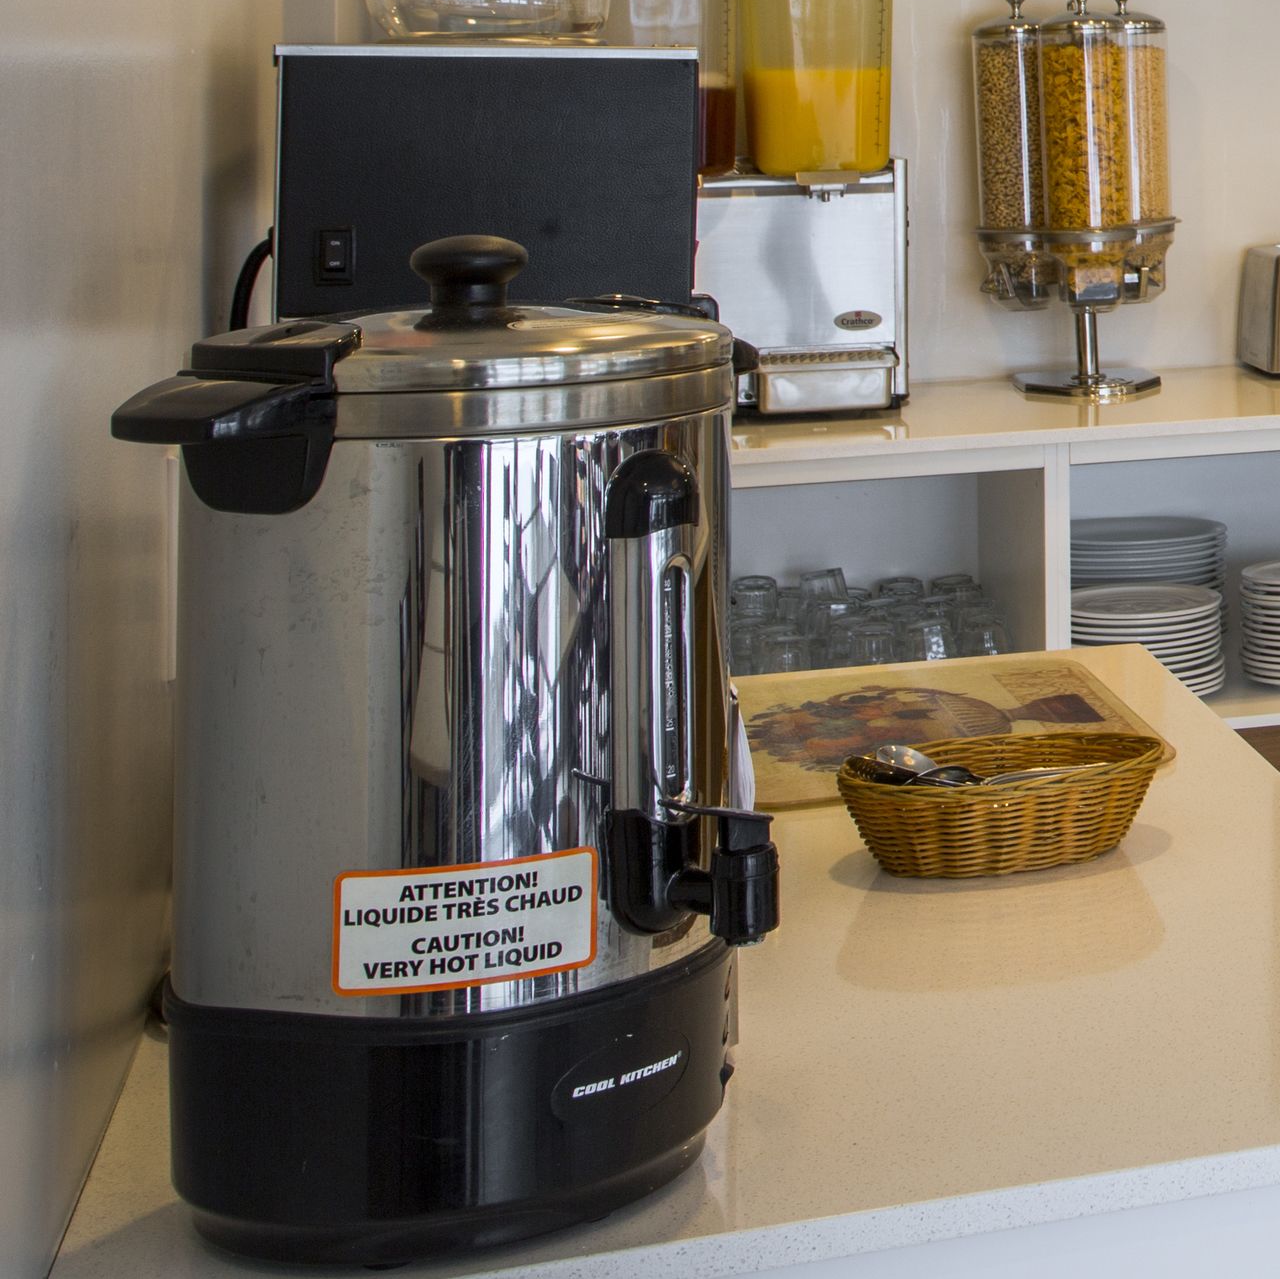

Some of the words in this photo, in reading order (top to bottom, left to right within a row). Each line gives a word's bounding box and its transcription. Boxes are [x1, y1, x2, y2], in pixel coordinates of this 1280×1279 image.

[841, 317, 873, 326] Crathco
[399, 871, 539, 902] ATTENTION!
[344, 904, 438, 928] LIQUIDE
[442, 896, 500, 920] TRÈS
[504, 885, 583, 912] CHAUD
[411, 926, 525, 955] CAUTION!
[363, 959, 424, 980] VERY
[429, 954, 479, 975] HOT
[484, 941, 563, 969] LIQUID
[572, 1077, 617, 1099] COOL
[619, 1054, 679, 1086] KITCHEN
